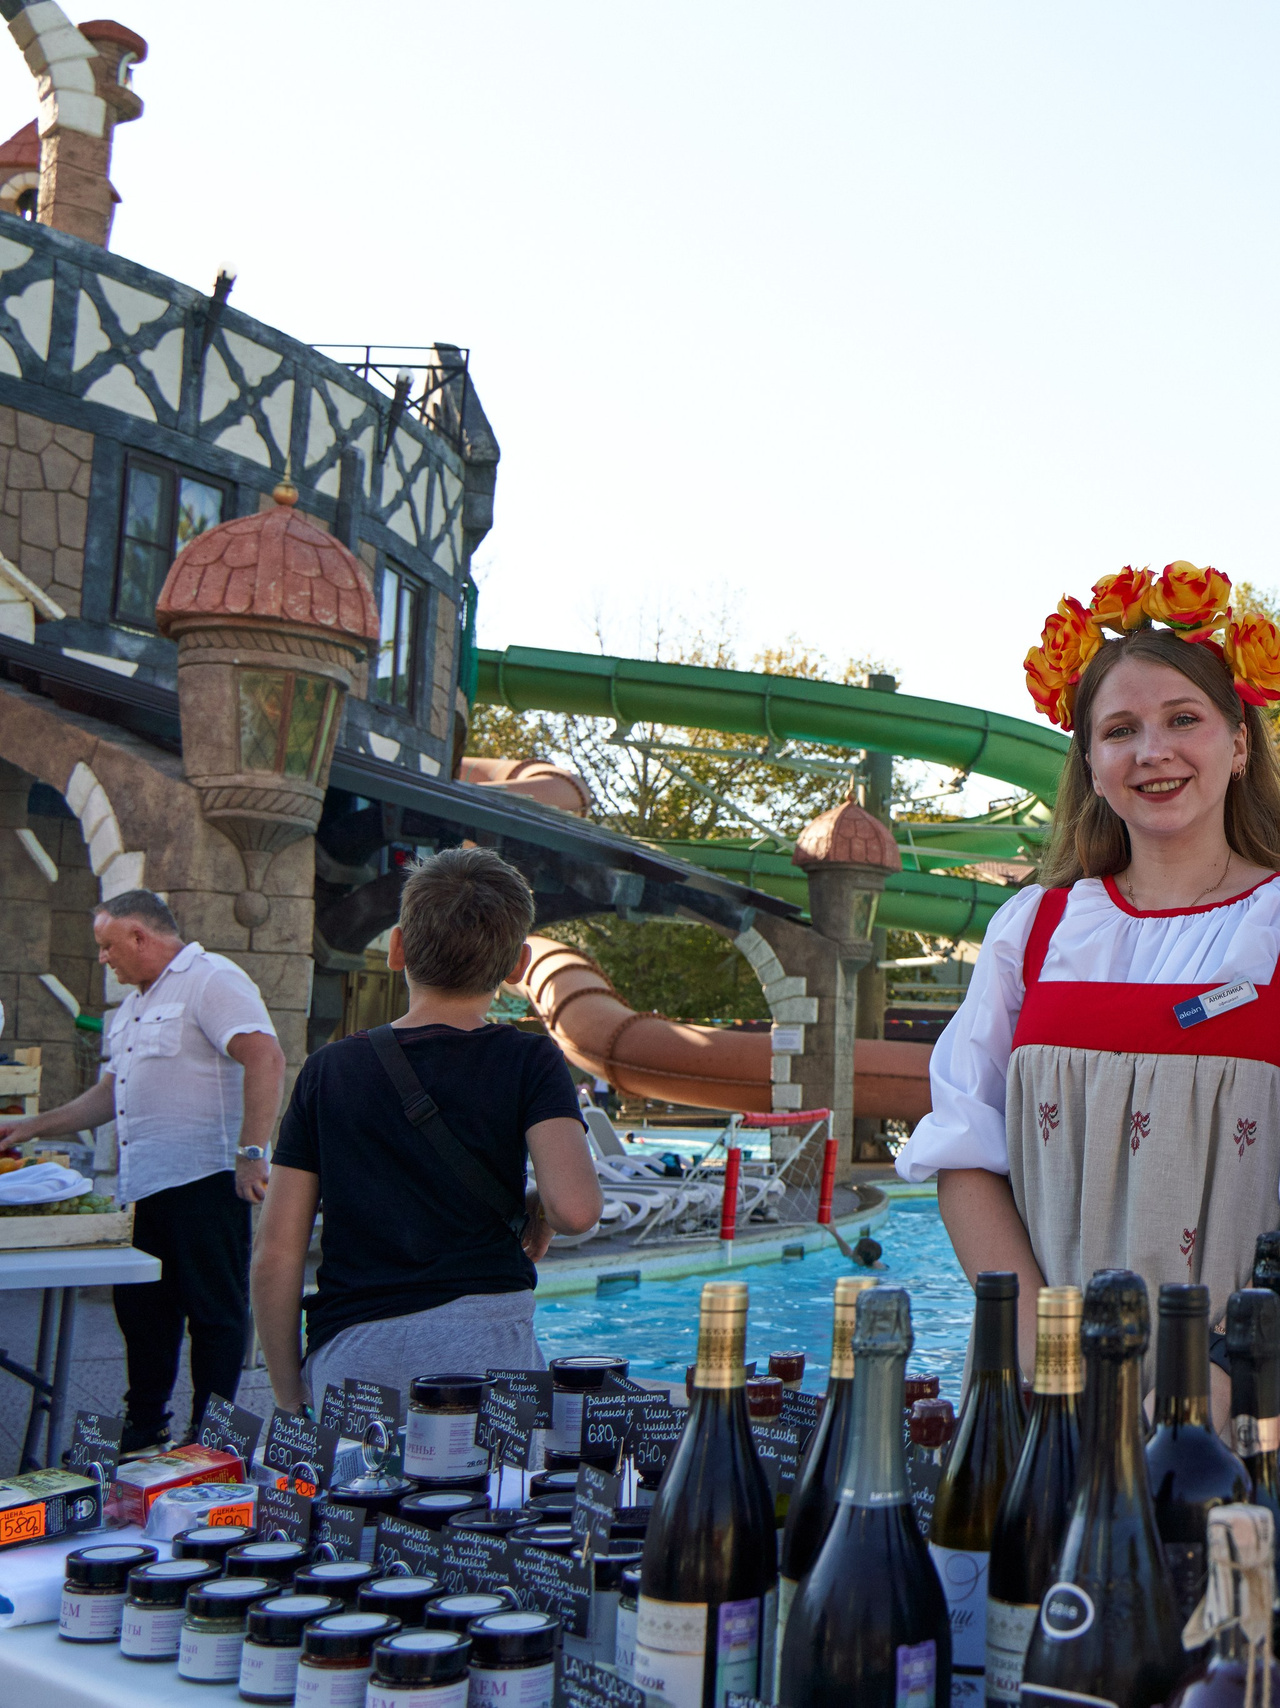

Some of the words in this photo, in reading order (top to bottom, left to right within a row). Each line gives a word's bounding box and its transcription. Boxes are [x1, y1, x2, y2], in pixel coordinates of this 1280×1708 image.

[1208, 985, 1244, 1004] АНЖЕЛИКА
[407, 1443, 436, 1456] РЕНЬЕ
[4, 1510, 26, 1520] ЦЕНА:
[216, 1507, 236, 1516] ЦЕНА:
[61, 1600, 81, 1618] ЕМ
[471, 1681, 508, 1697] ЖЕМ
